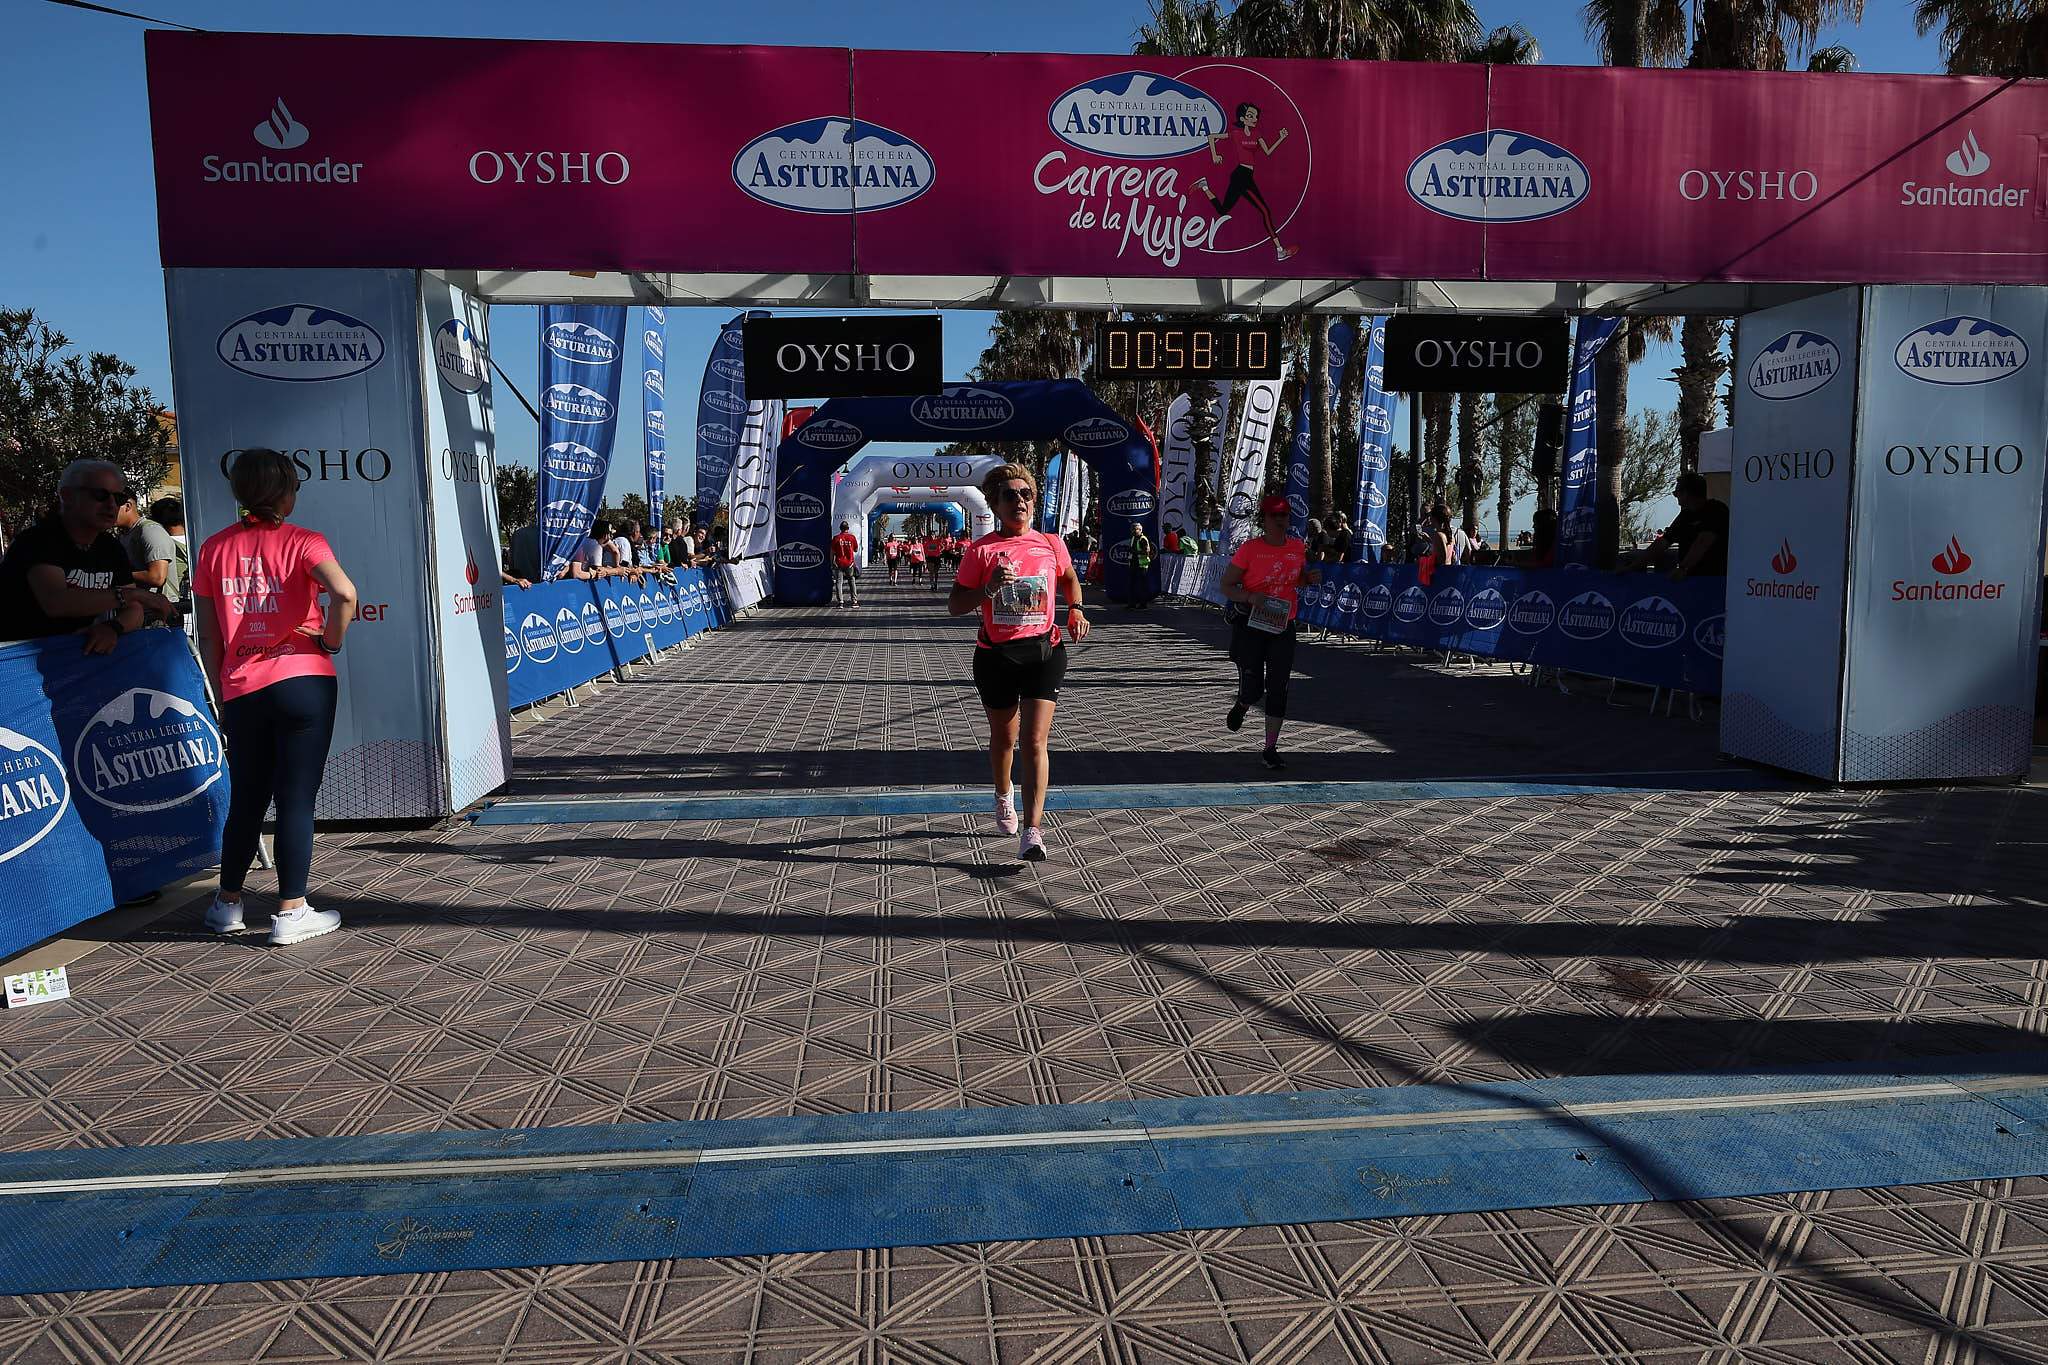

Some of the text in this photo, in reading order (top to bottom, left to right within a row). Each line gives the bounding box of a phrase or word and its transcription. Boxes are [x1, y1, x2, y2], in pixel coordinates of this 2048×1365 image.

[1089, 100, 1208, 113] CENTRAL LECHERA
[1063, 101, 1211, 138] ASTURIANA
[469, 150, 631, 185] OYSHO
[779, 150, 843, 161] CENTRAL
[1449, 160, 1571, 171] CENTRAL LECHERA
[202, 155, 363, 184] Santander
[749, 151, 920, 188] ASTURIANA
[1032, 150, 1180, 200] Carrera
[1420, 160, 1575, 199] ASTURIANA
[1678, 168, 1819, 202] OYSHO
[1901, 180, 2030, 208] Santander
[1069, 196, 1232, 268] de la Mujer
[254, 330, 366, 340] CENTRAL LECHERA
[548, 330, 613, 359] ASTURIANA
[1925, 339, 2015, 348] CENTRAL LECHERA
[230, 332, 373, 363] ASTURIANA
[776, 343, 916, 373] OYSHO
[1108, 331, 1268, 370] 00:58:10
[1413, 338, 1544, 370] OYSHO
[1766, 347, 1831, 366] CENTRAL LECHERA
[1903, 342, 2018, 368] ASTURIANA
[1753, 357, 1833, 388] ASTURIANA
[918, 400, 1007, 421] ASTURIANA
[801, 430, 858, 443] ASTURIANA
[1068, 429, 1126, 442] ASTURIANA
[1228, 384, 1275, 520] OYSHO
[1885, 444, 2023, 476] OYSHO
[220, 447, 392, 483] SHO
[441, 447, 491, 486] OYSHO
[892, 461, 973, 480] OYSHO
[1744, 448, 1834, 483] OYSHO
[845, 480, 870, 488] OYSHO
[778, 502, 822, 515] ASTURIANA
[834, 512, 859, 520] OYSHO
[240, 557, 264, 575] TU
[778, 550, 822, 564] ASTURIANA
[221, 575, 285, 596] DORSAL
[1745, 577, 1820, 601] Santander
[1891, 579, 2006, 601] Santander
[231, 596, 280, 615] SUMA
[453, 591, 494, 616] Santander
[1467, 607, 1503, 620] ASTURIANA
[249, 622, 267, 632] 2024
[1510, 608, 1550, 625] ASTURIANA
[1561, 607, 1610, 630] ASTURIANA
[1622, 612, 1677, 638] ASTURIANA
[107, 721, 202, 748] CENTRAL LECHER
[0, 754, 42, 776] HERA
